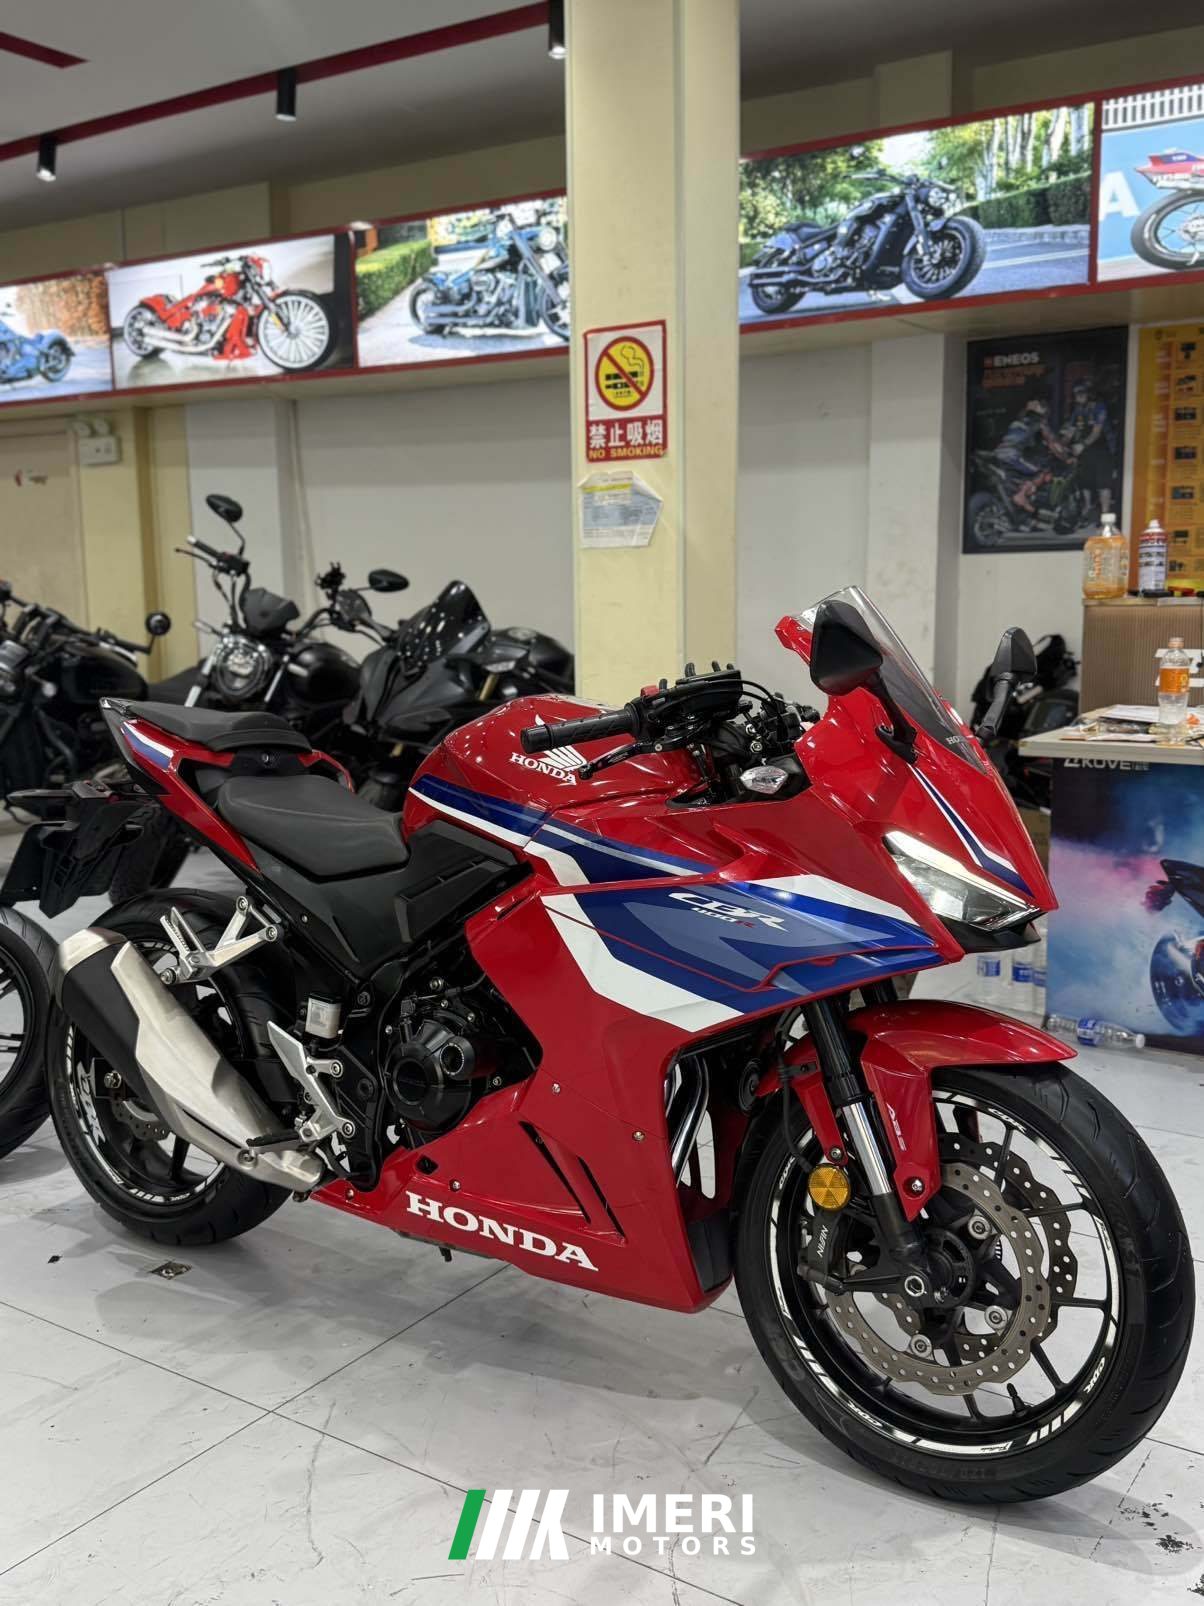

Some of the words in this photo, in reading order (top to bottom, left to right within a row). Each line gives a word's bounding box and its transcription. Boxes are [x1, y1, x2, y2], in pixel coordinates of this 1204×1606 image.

[993, 351, 1040, 367] ENEOS
[589, 420, 663, 449] 禁止吸烟
[589, 448, 605, 459] NO
[610, 444, 664, 457] SMOKING
[510, 751, 577, 786] HONDA
[668, 892, 789, 932] CBR
[405, 1190, 599, 1272] HONDA
